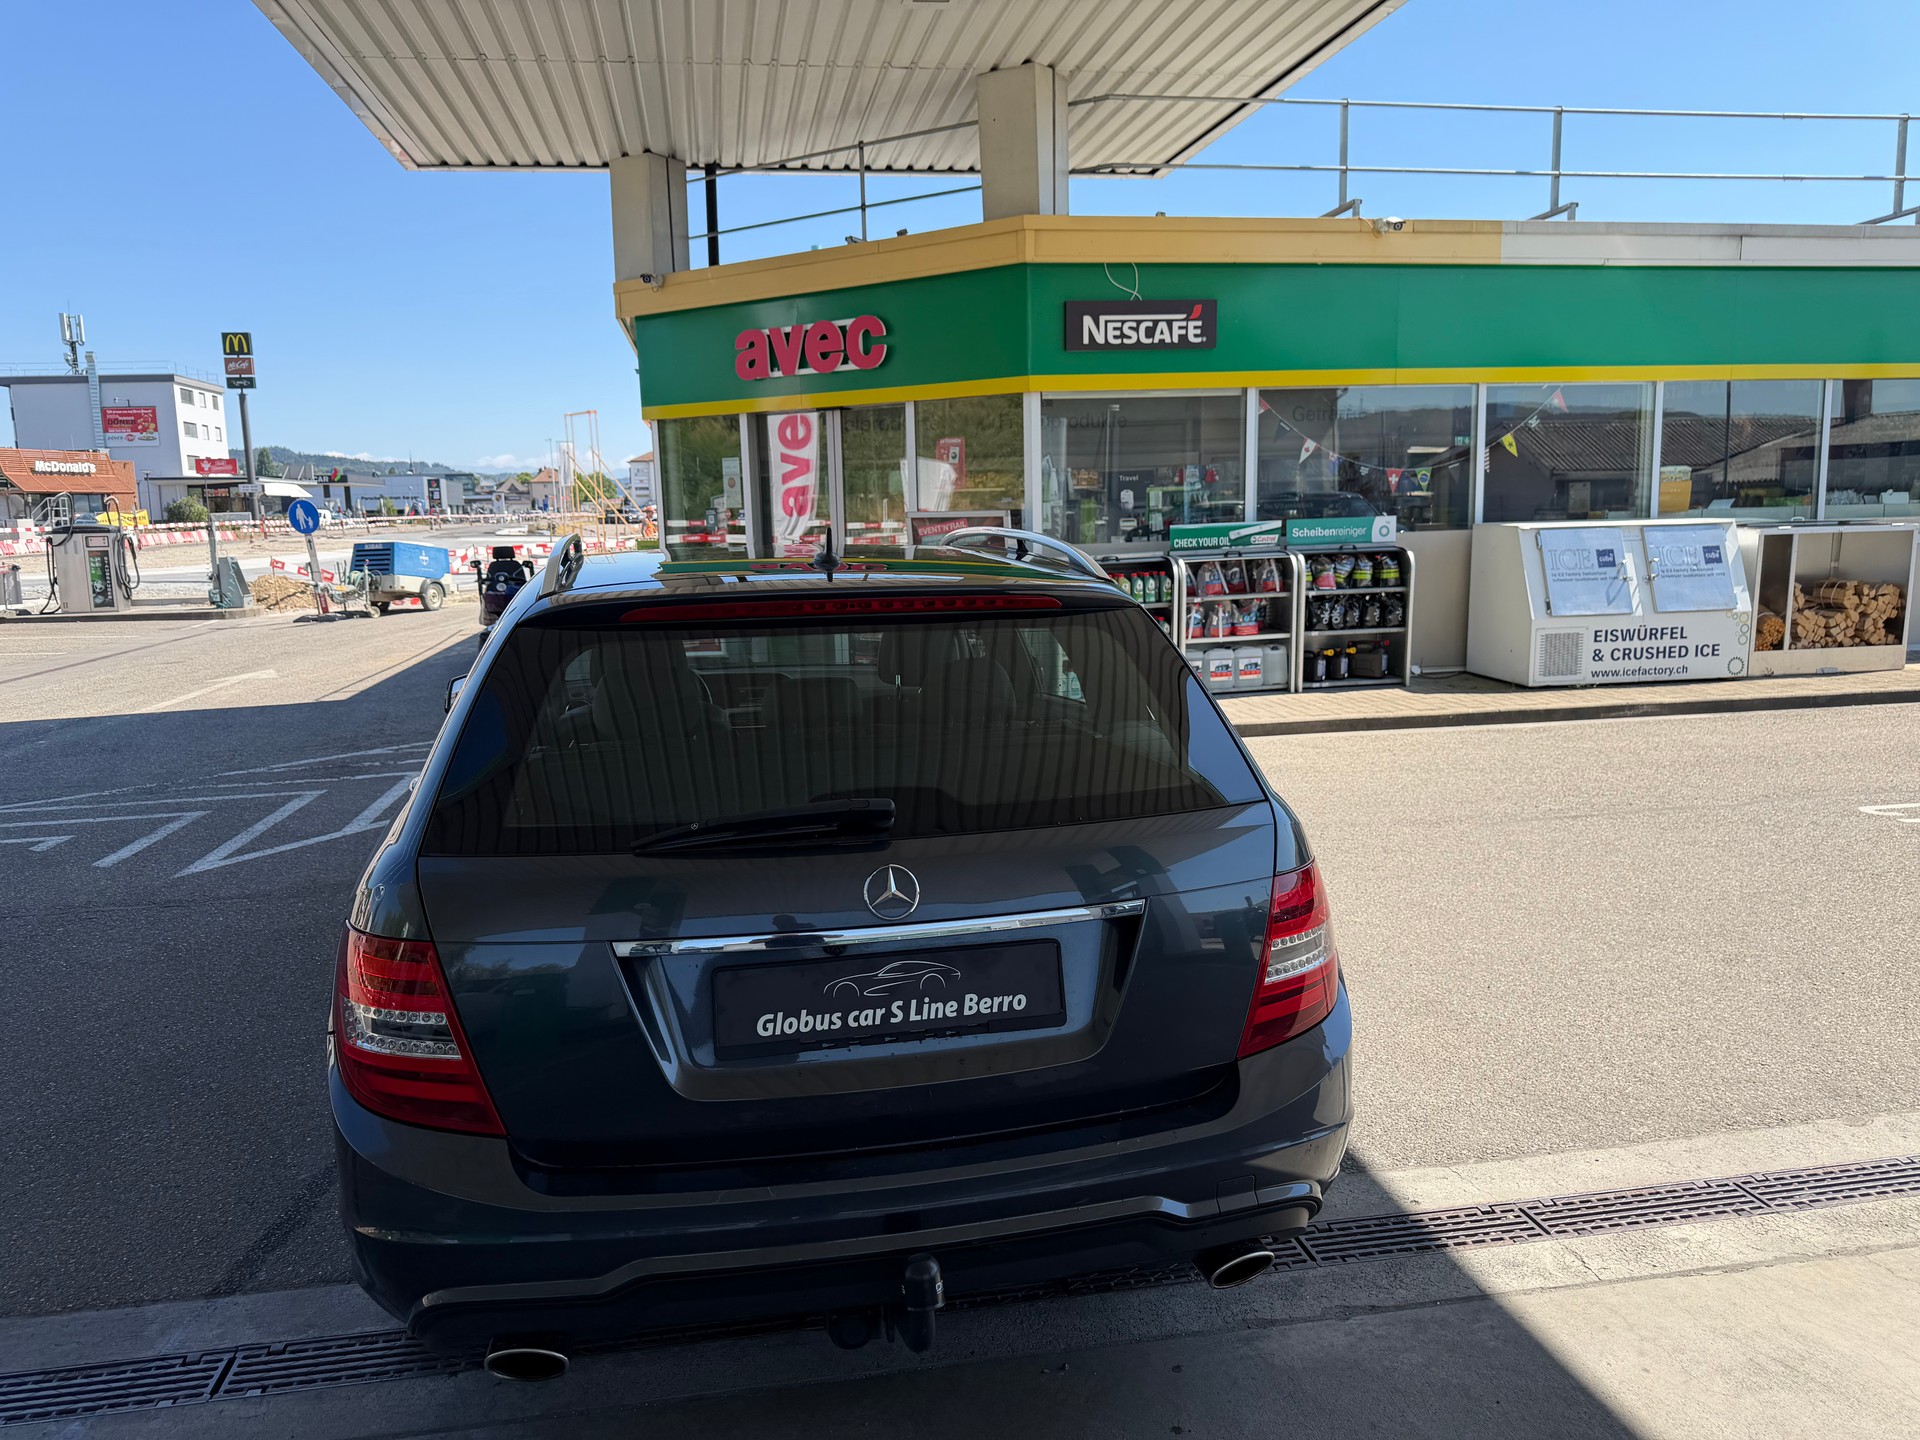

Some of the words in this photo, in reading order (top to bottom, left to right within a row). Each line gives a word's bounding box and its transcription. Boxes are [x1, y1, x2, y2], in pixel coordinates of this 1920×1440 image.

[1082, 303, 1207, 345] NESCAFÉ
[735, 314, 888, 381] avec
[34, 460, 97, 473] McDonald's
[1119, 474, 1139, 482] Travel
[1291, 526, 1367, 538] Scheibenreiniger
[1173, 538, 1198, 548] CHECK
[1198, 537, 1219, 547] YOUR
[1219, 536, 1231, 546] OIL
[1548, 548, 1595, 571] ICE
[1656, 544, 1701, 567] ICE
[1593, 625, 1688, 643] EISWÜRFEL
[1592, 648, 1605, 662] &
[1610, 645, 1689, 661] CRUSHED
[1694, 643, 1721, 657] ICE
[1591, 665, 1688, 678] www.icefactory.ch
[756, 1009, 842, 1037] Globus
[847, 1007, 885, 1027] car
[889, 1000, 904, 1023] S
[909, 996, 958, 1022] Line
[963, 993, 1027, 1016] Berro
